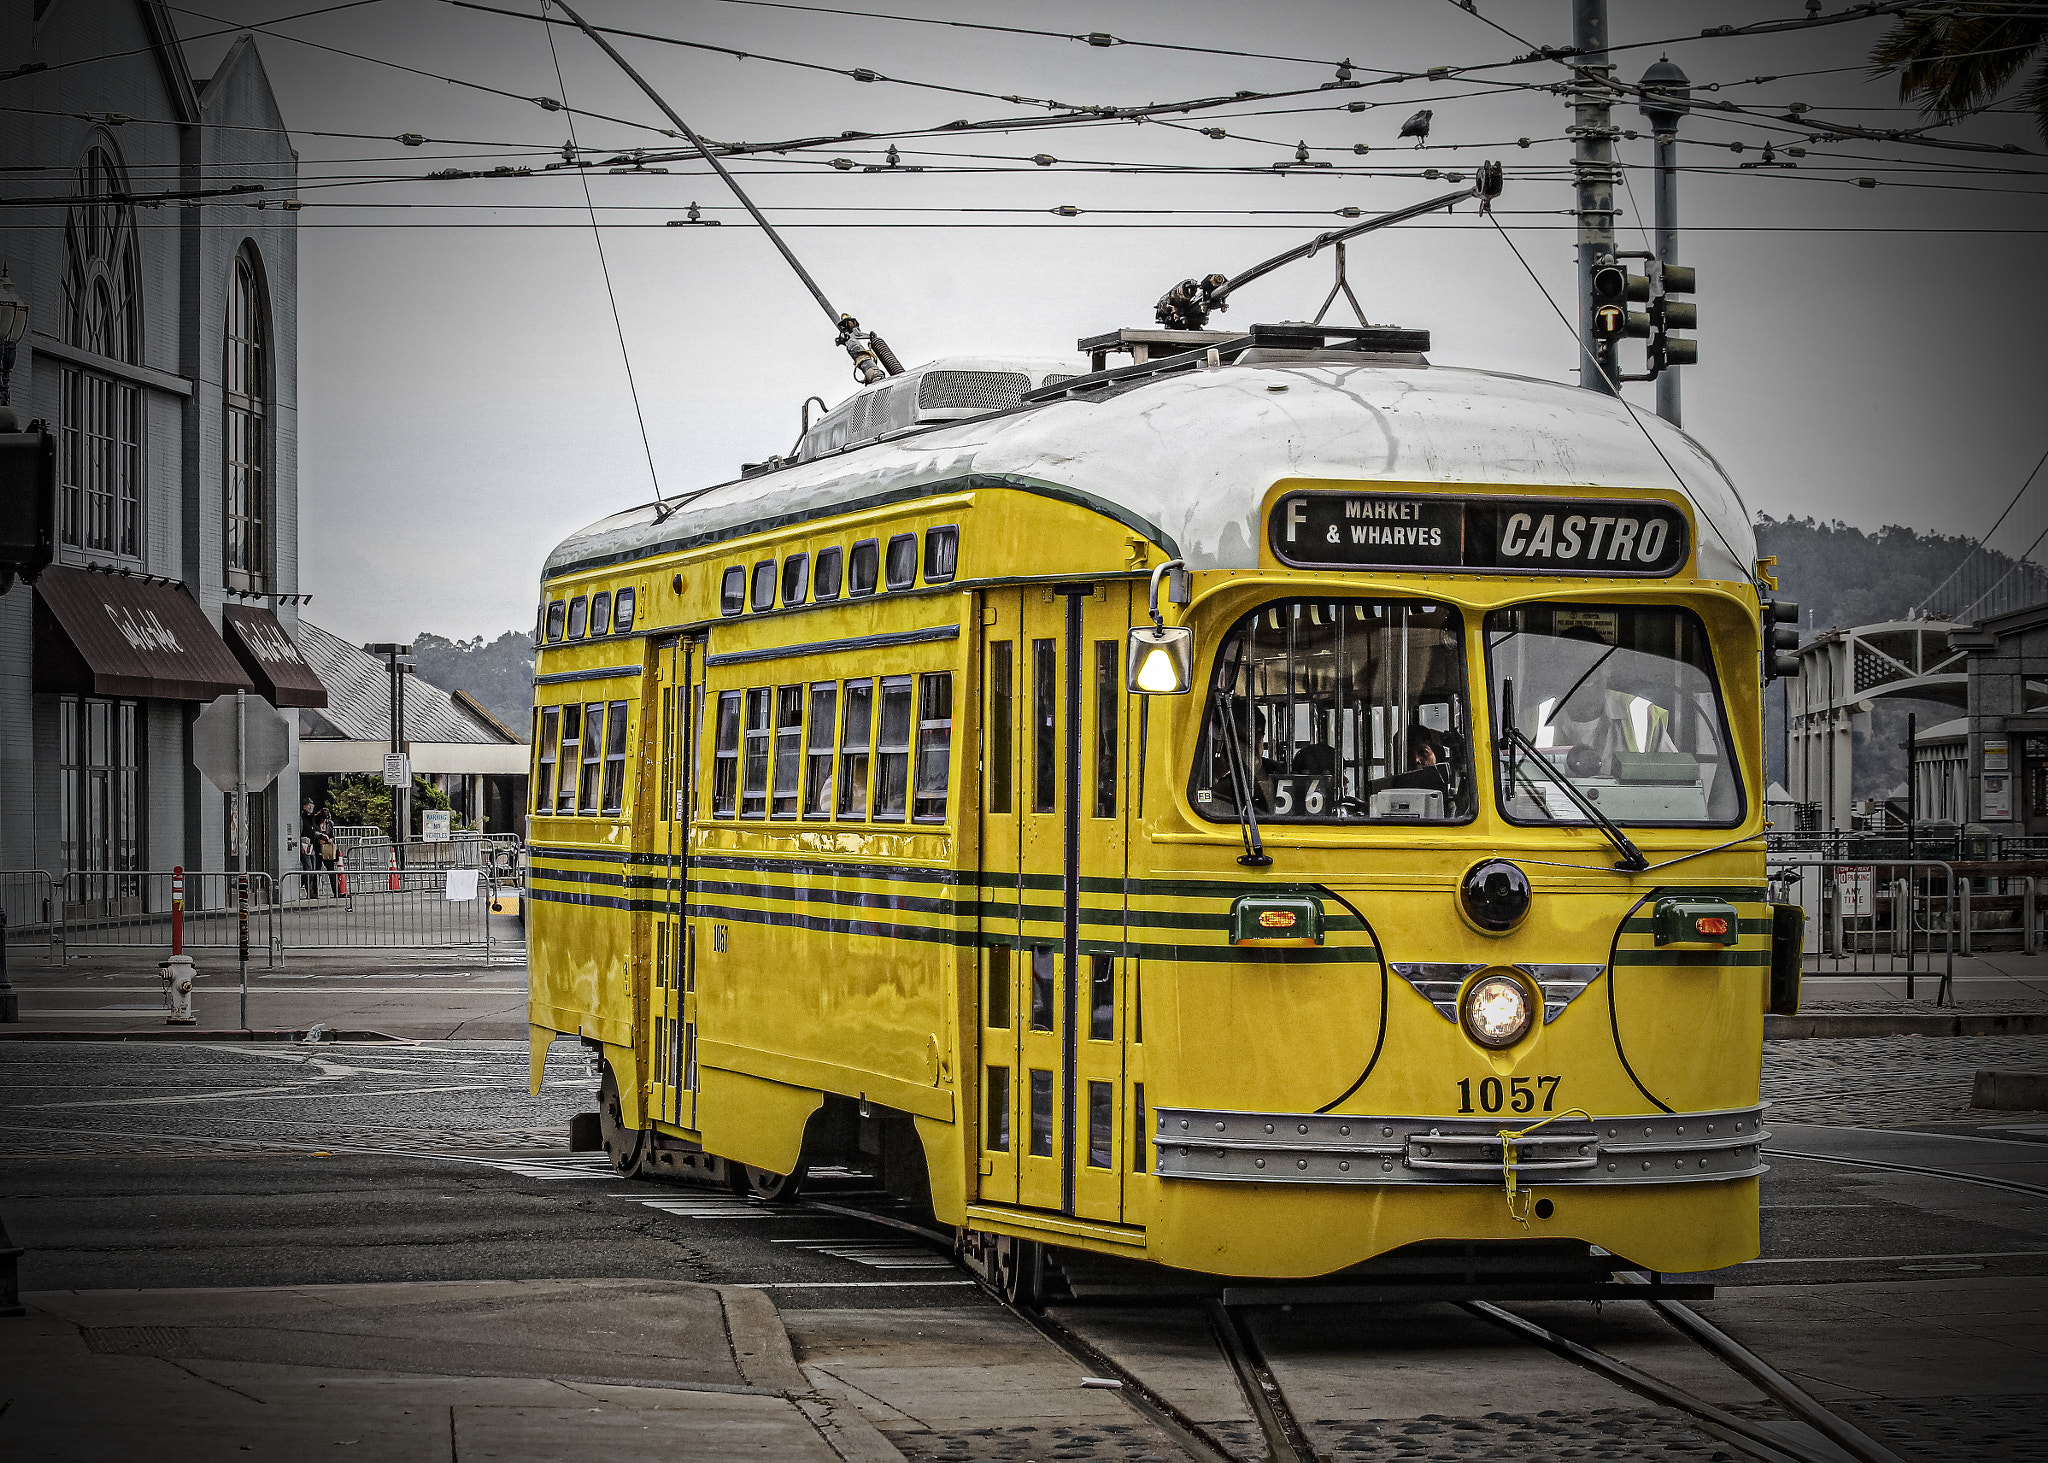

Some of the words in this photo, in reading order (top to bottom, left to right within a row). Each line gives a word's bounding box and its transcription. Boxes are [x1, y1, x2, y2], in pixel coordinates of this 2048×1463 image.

[1286, 499, 1307, 542] F
[1345, 500, 1423, 521] MARKET
[1326, 525, 1341, 544] &
[1351, 526, 1442, 546] WHARVES
[1501, 513, 1669, 563] CASTRO
[713, 924, 728, 953] 1057
[1456, 1075, 1562, 1113] 1057
